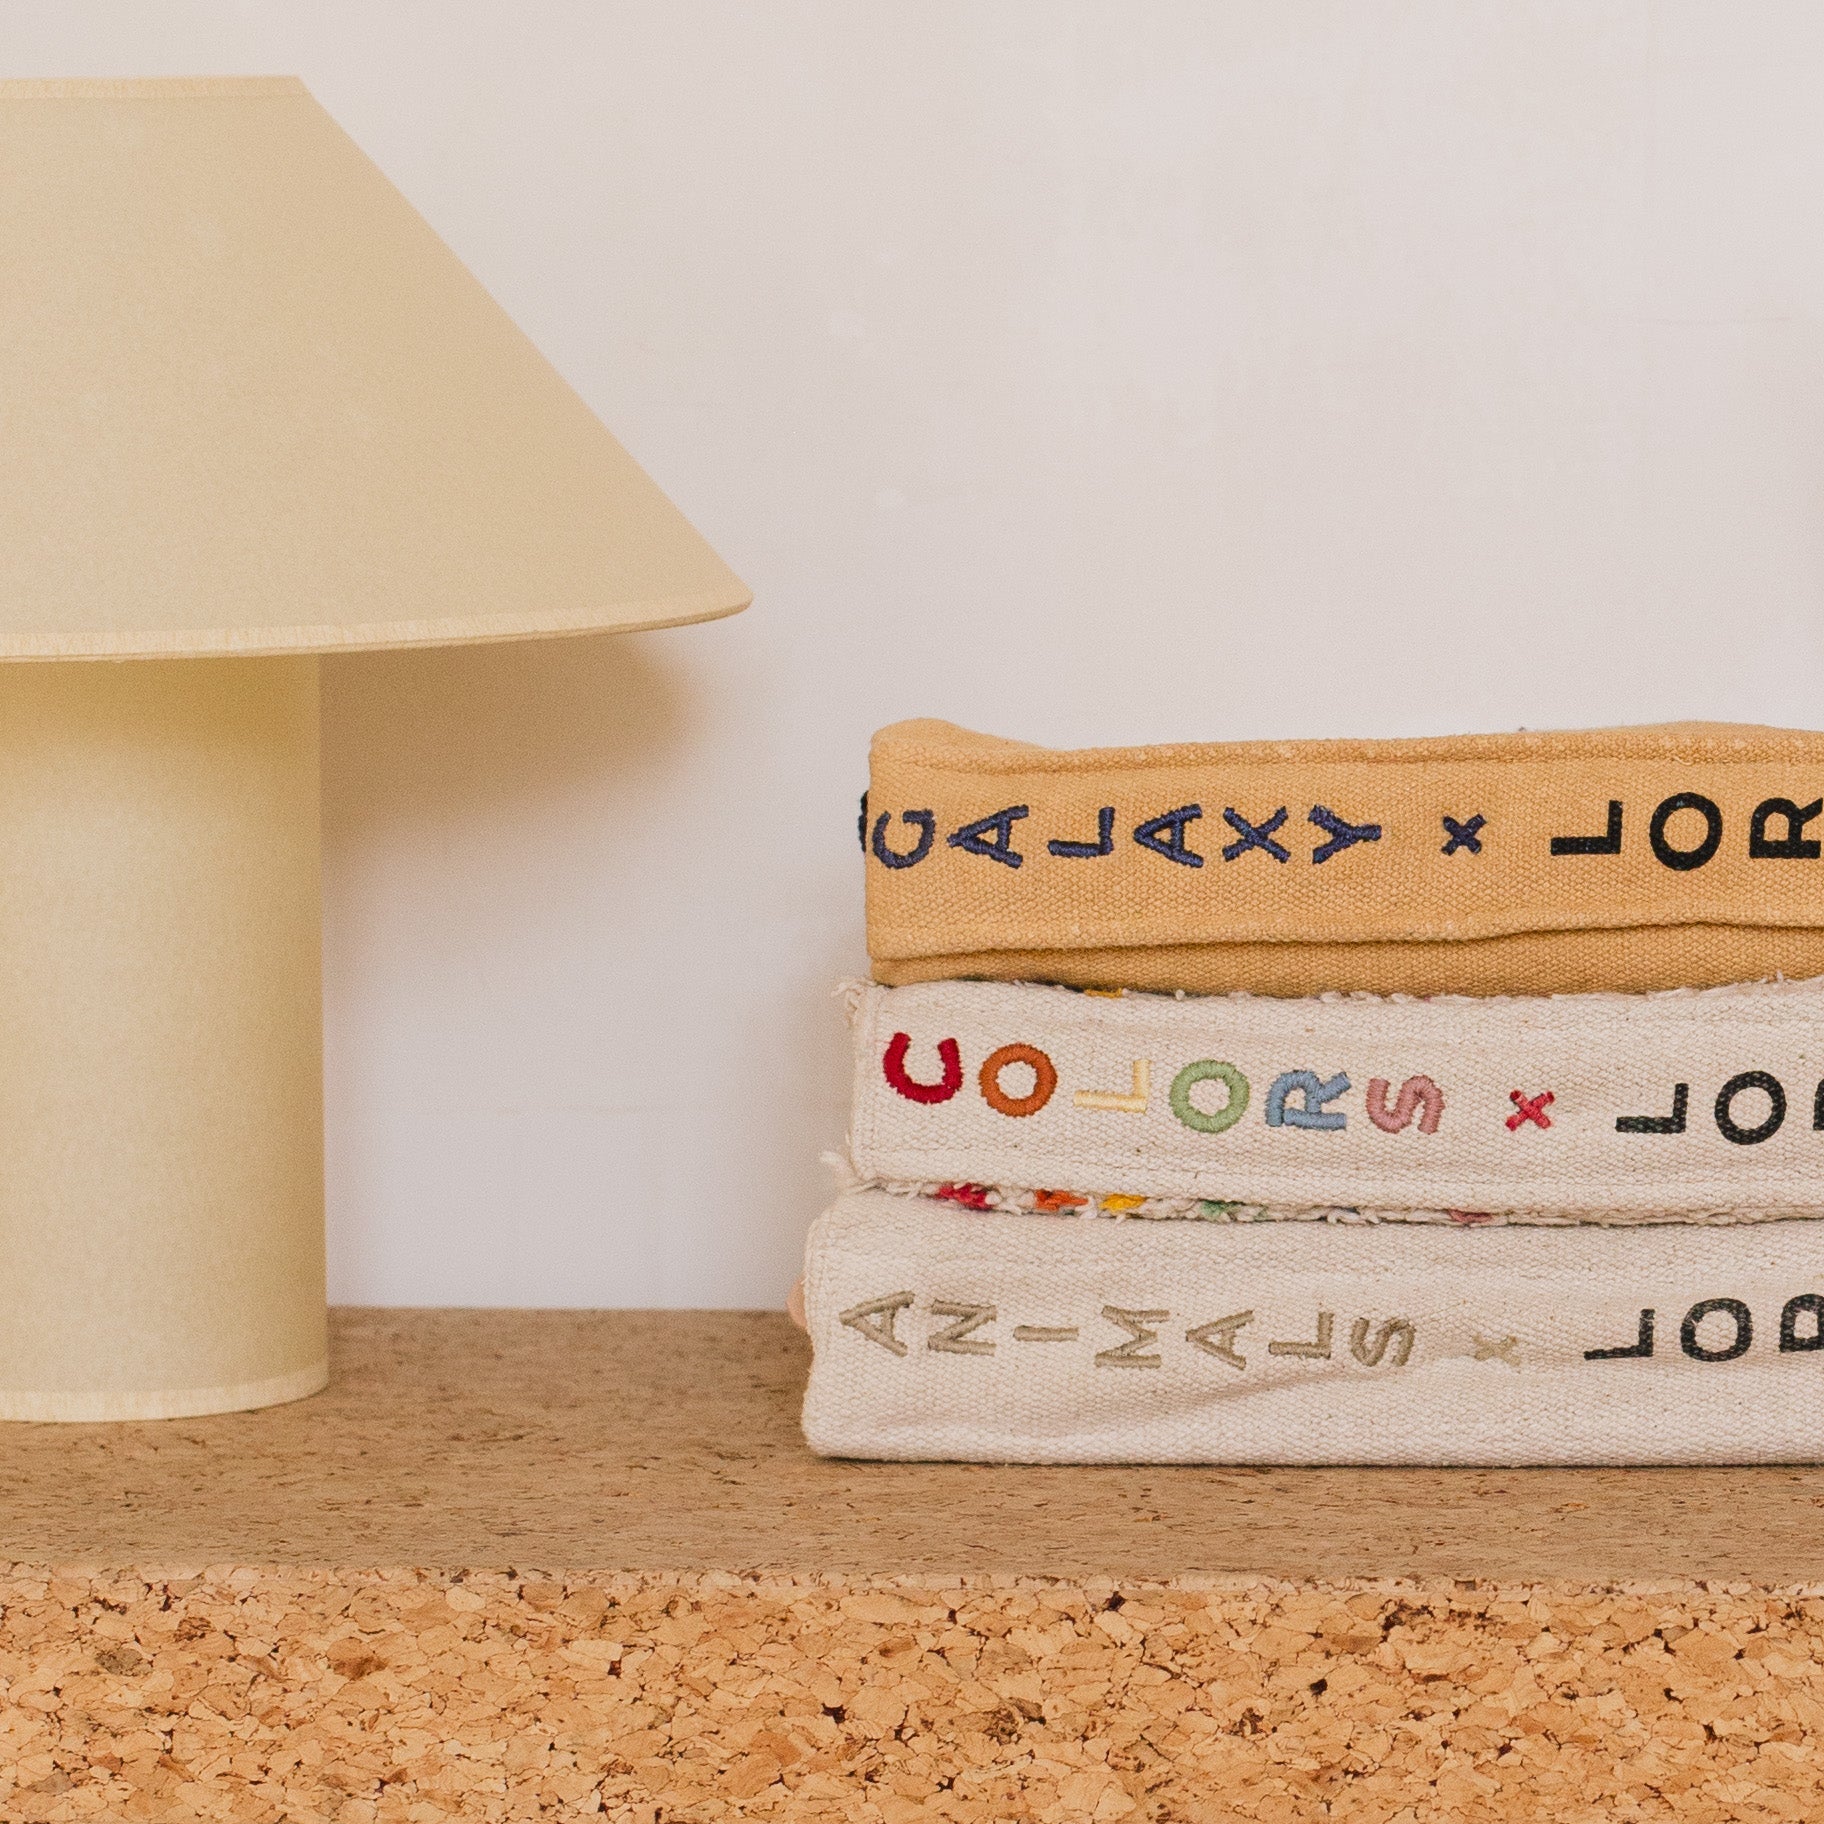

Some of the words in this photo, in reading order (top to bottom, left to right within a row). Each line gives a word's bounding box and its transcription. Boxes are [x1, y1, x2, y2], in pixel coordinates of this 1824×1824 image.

[871, 802, 1383, 871] GALAXY
[882, 1032, 1445, 1136] COLORS
[838, 1289, 1417, 1371] ANIMALS
